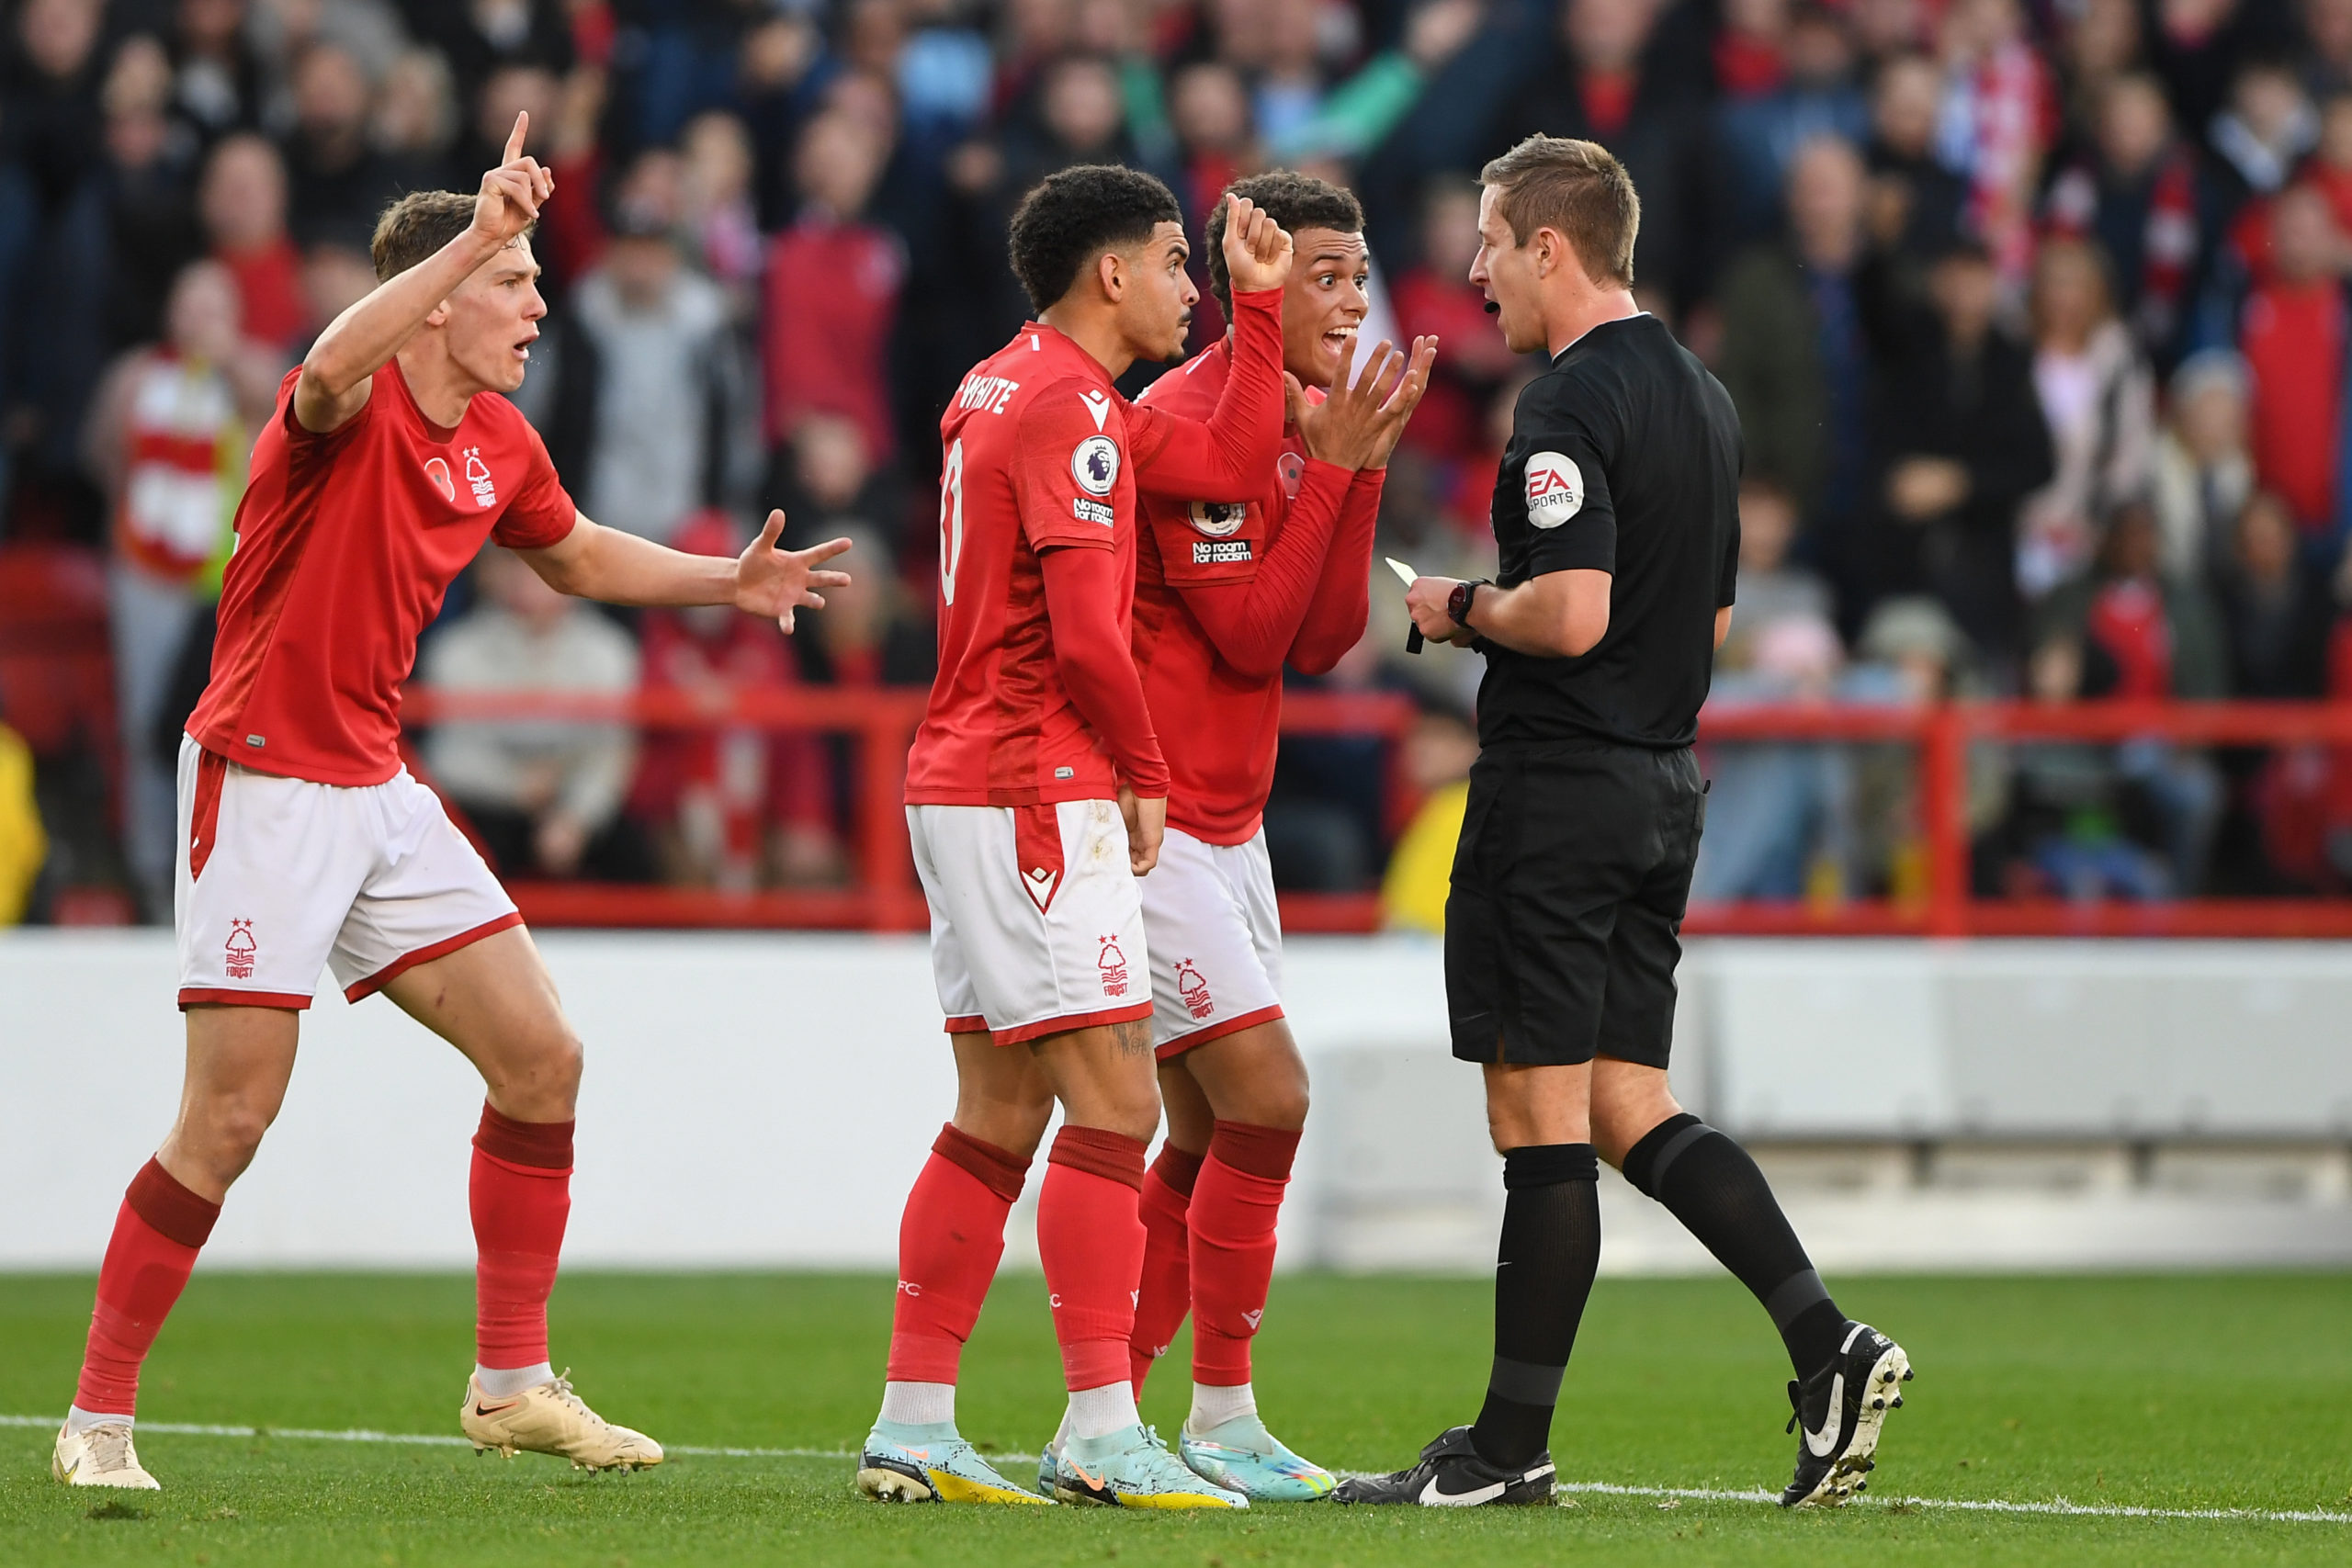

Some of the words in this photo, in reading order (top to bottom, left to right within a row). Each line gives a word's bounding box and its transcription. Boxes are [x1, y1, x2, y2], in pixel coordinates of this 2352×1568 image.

[1529, 468, 1571, 498] EA
[1073, 497, 1091, 511] No
[1091, 502, 1114, 518] room
[1193, 542, 1212, 554] No
[1213, 541, 1247, 553] room
[1213, 550, 1253, 563] racism
